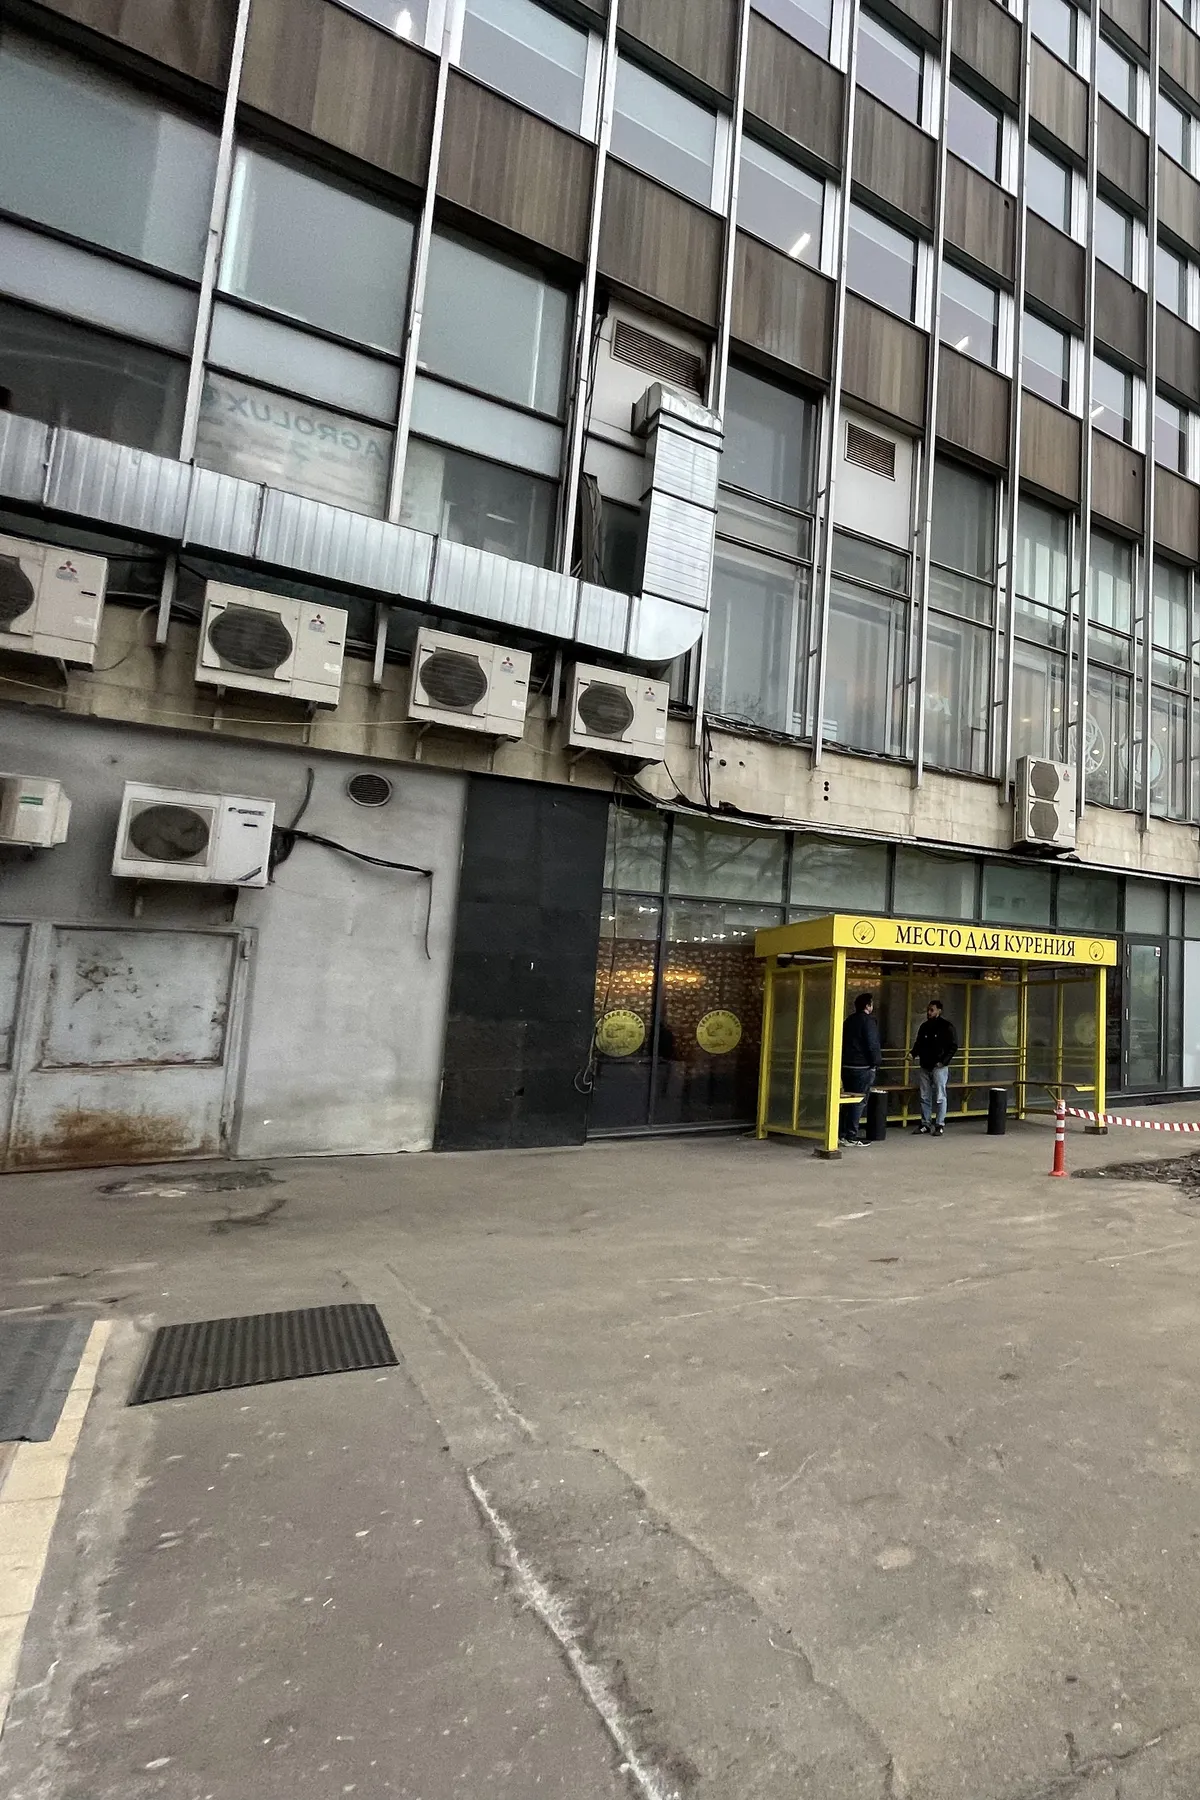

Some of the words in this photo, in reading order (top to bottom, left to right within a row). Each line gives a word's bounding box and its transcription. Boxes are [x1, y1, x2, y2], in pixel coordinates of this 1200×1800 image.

[895, 926, 962, 948] МЕСТО
[966, 932, 1000, 953] ДЛЯ
[1004, 935, 1076, 956] КУРЕНИЯ
